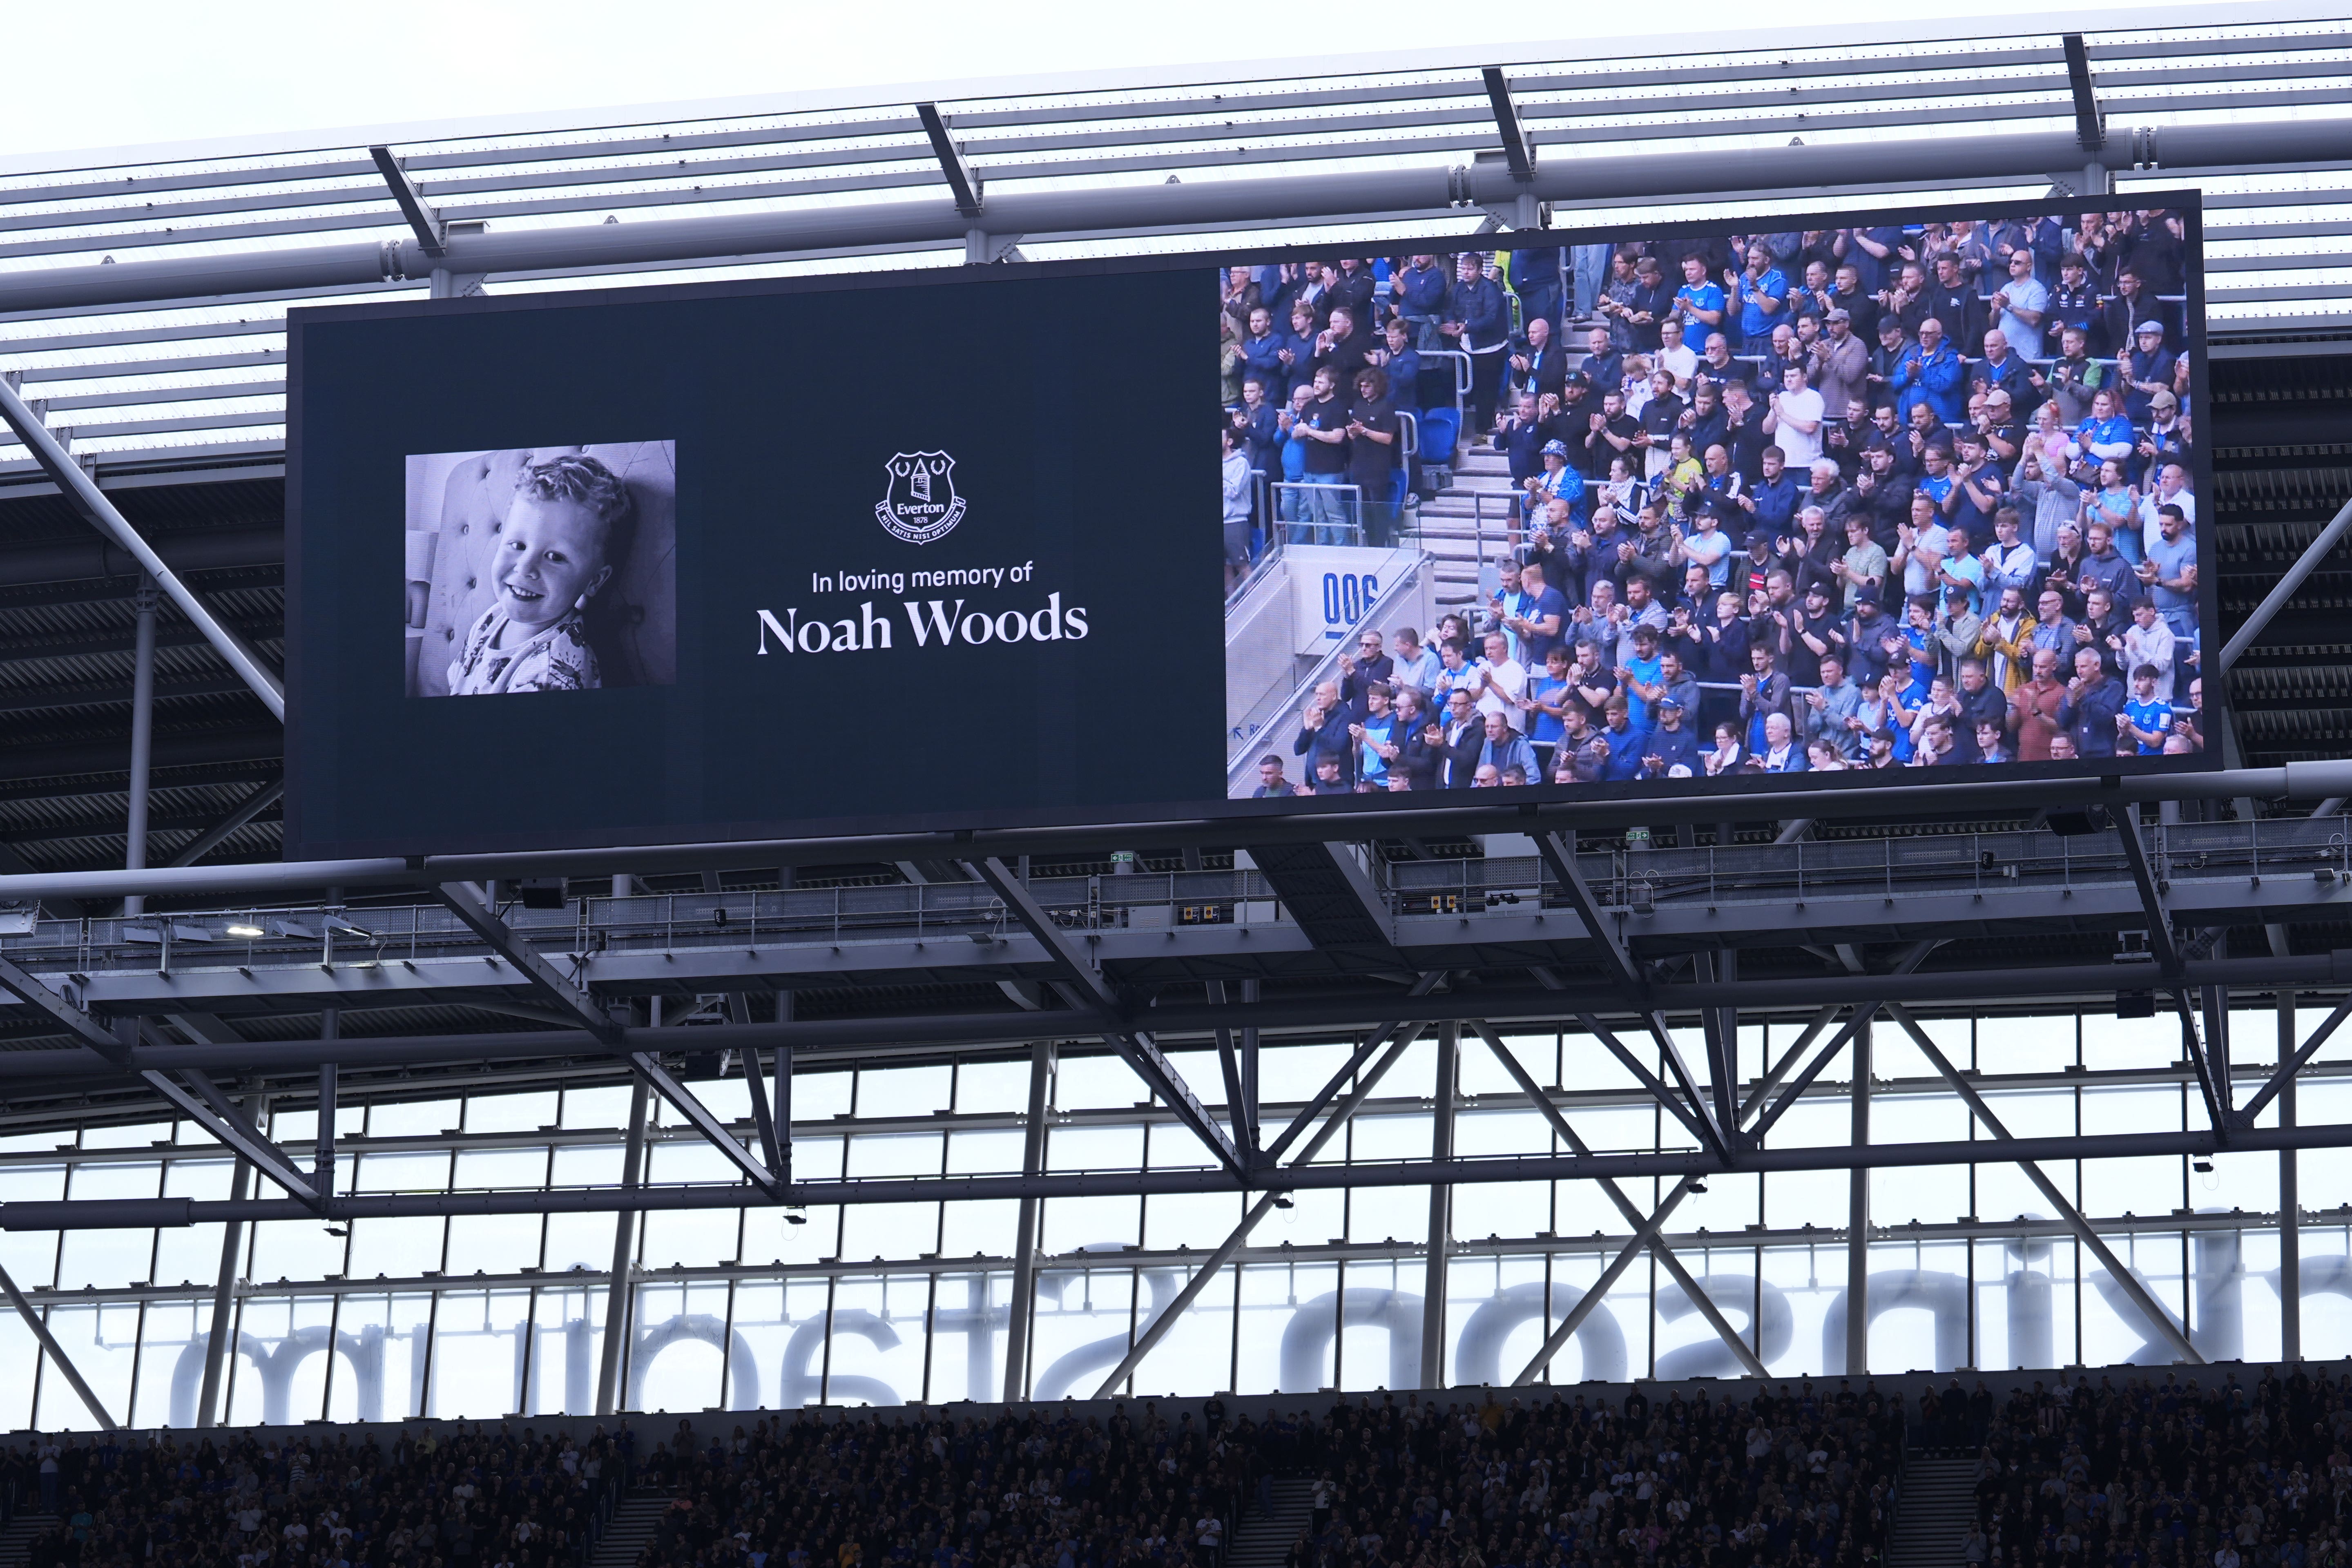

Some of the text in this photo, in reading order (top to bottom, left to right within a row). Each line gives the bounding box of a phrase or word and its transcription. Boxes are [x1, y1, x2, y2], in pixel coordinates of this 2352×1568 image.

[897, 502, 944, 515] Everton
[881, 514, 893, 528] NIL
[891, 525, 911, 539] SATIS
[932, 511, 960, 537] OPTIMUM
[813, 560, 1033, 594] In loving memory of
[756, 591, 1088, 655] Noah Woods
